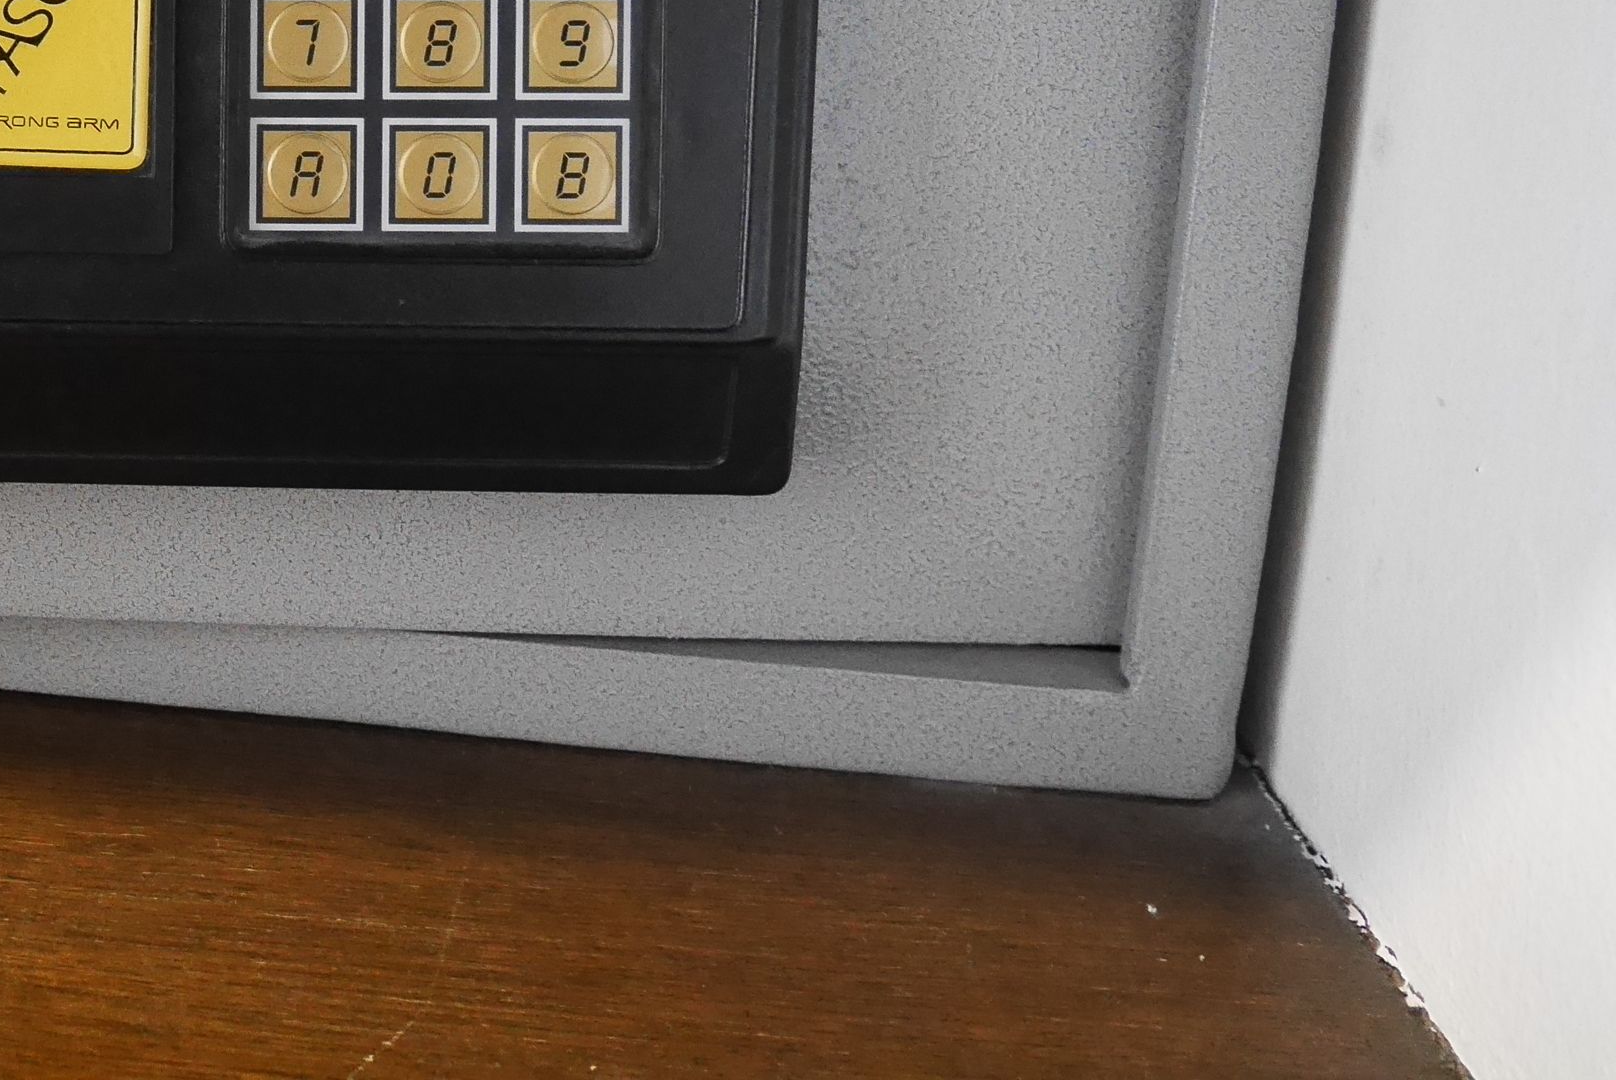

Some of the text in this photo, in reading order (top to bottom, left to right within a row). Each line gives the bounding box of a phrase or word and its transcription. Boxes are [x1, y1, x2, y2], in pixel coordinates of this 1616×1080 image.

[295, 19, 591, 67] 7 8 9
[290, 151, 324, 198] A
